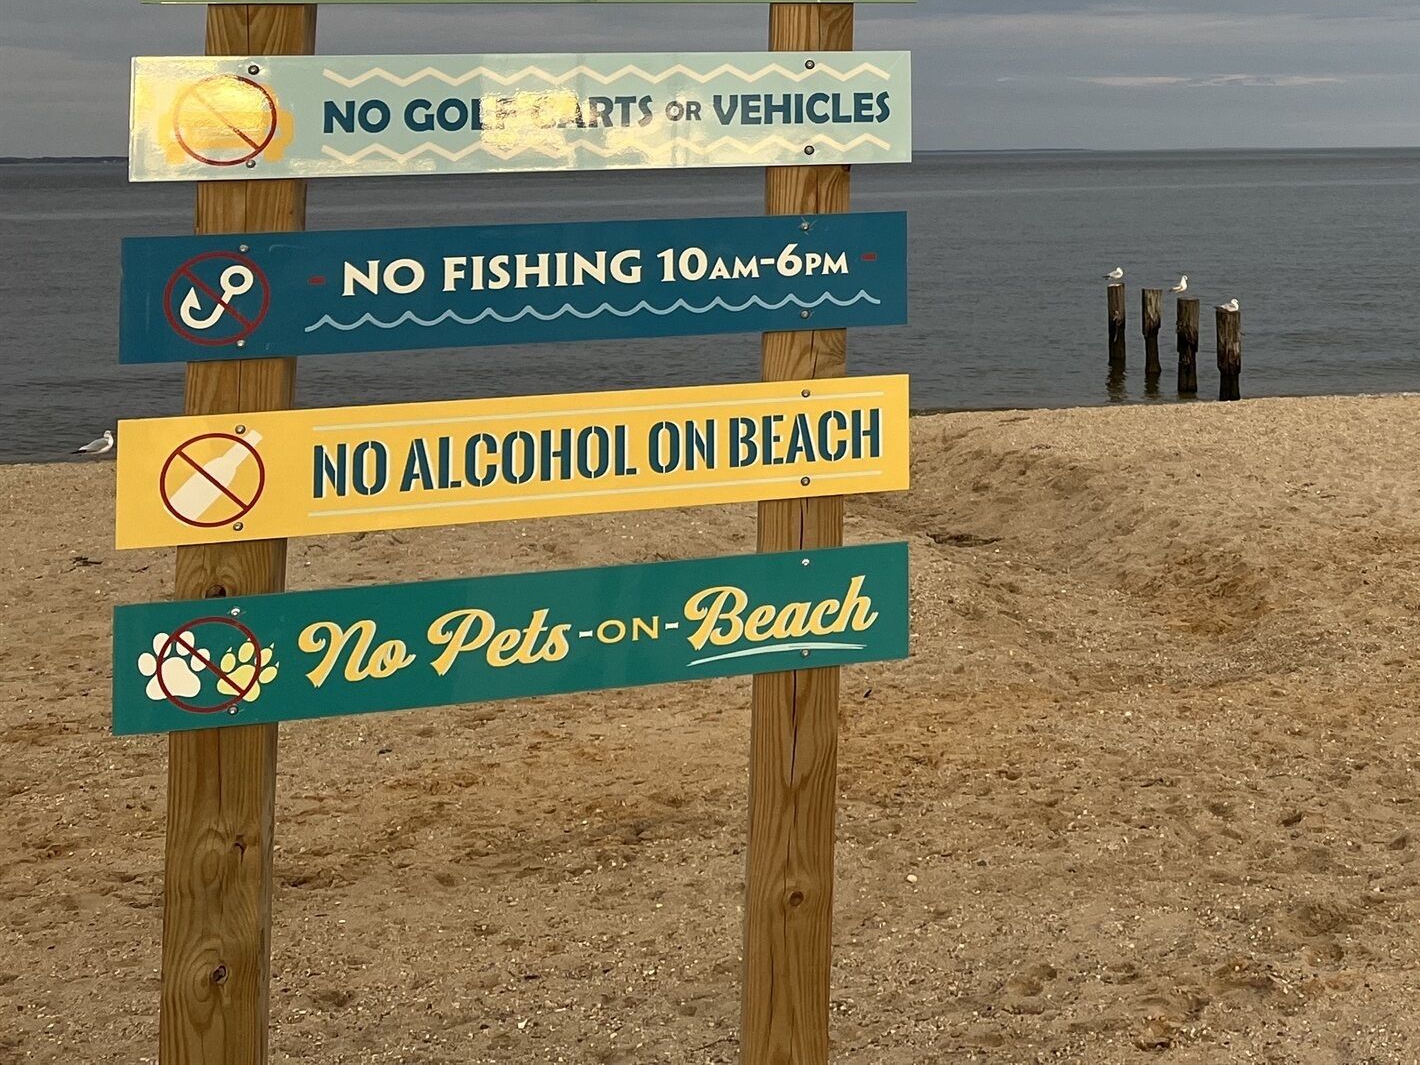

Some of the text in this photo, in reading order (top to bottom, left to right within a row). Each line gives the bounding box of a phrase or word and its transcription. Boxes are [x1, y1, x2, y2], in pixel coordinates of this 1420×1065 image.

[323, 99, 391, 134] NO
[665, 100, 702, 123] OR
[712, 90, 891, 126] VEHICLES
[341, 260, 426, 297] NO
[442, 249, 642, 292] FISHING
[312, 406, 883, 499] NO ALCOHOL ON BEACH
[297, 618, 418, 688] No
